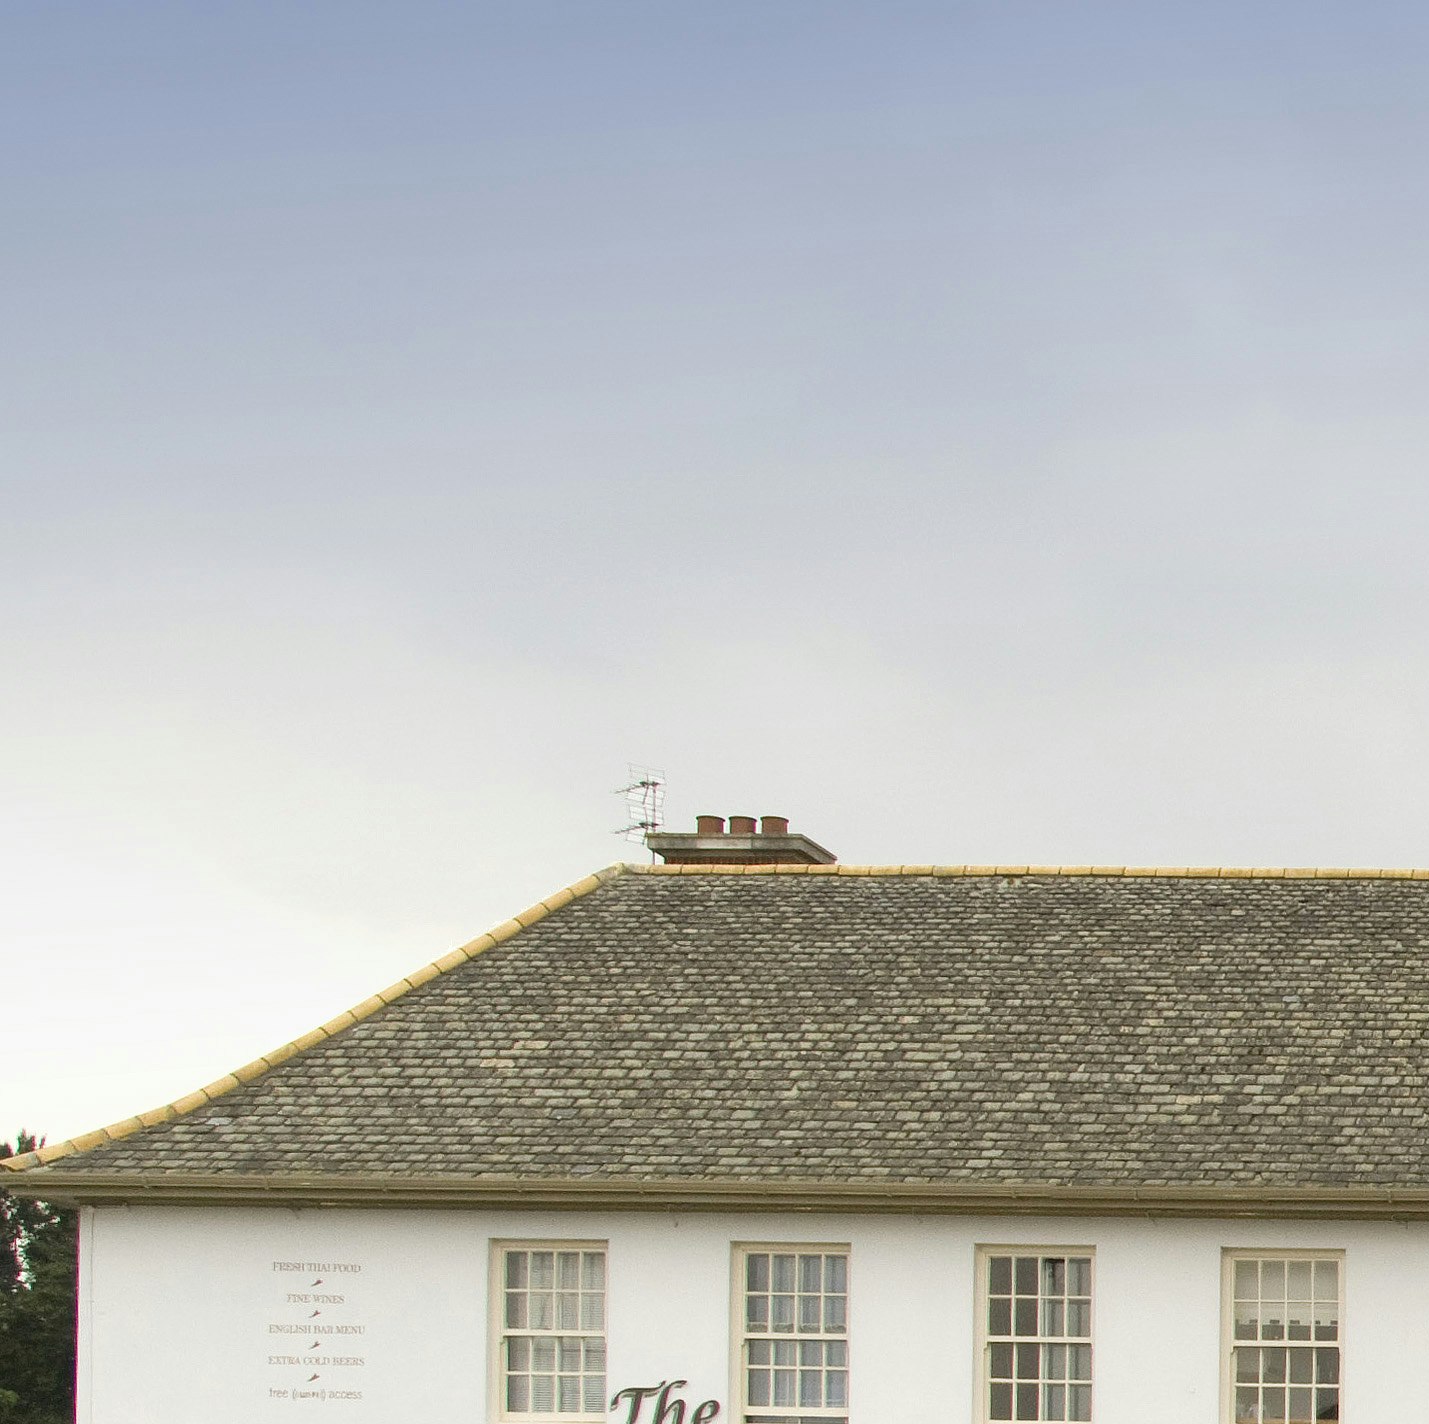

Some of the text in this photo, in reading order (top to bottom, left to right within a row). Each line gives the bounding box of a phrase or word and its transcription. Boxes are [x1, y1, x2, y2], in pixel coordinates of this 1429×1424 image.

[272, 1261, 362, 1273] FRESH THAI FOOD
[286, 1293, 345, 1304] FINE WINES
[268, 1324, 365, 1336] ENGLISH BAR MENU
[268, 1356, 365, 1367] EXTRA COLD BEERS
[328, 1390, 363, 1400] access
